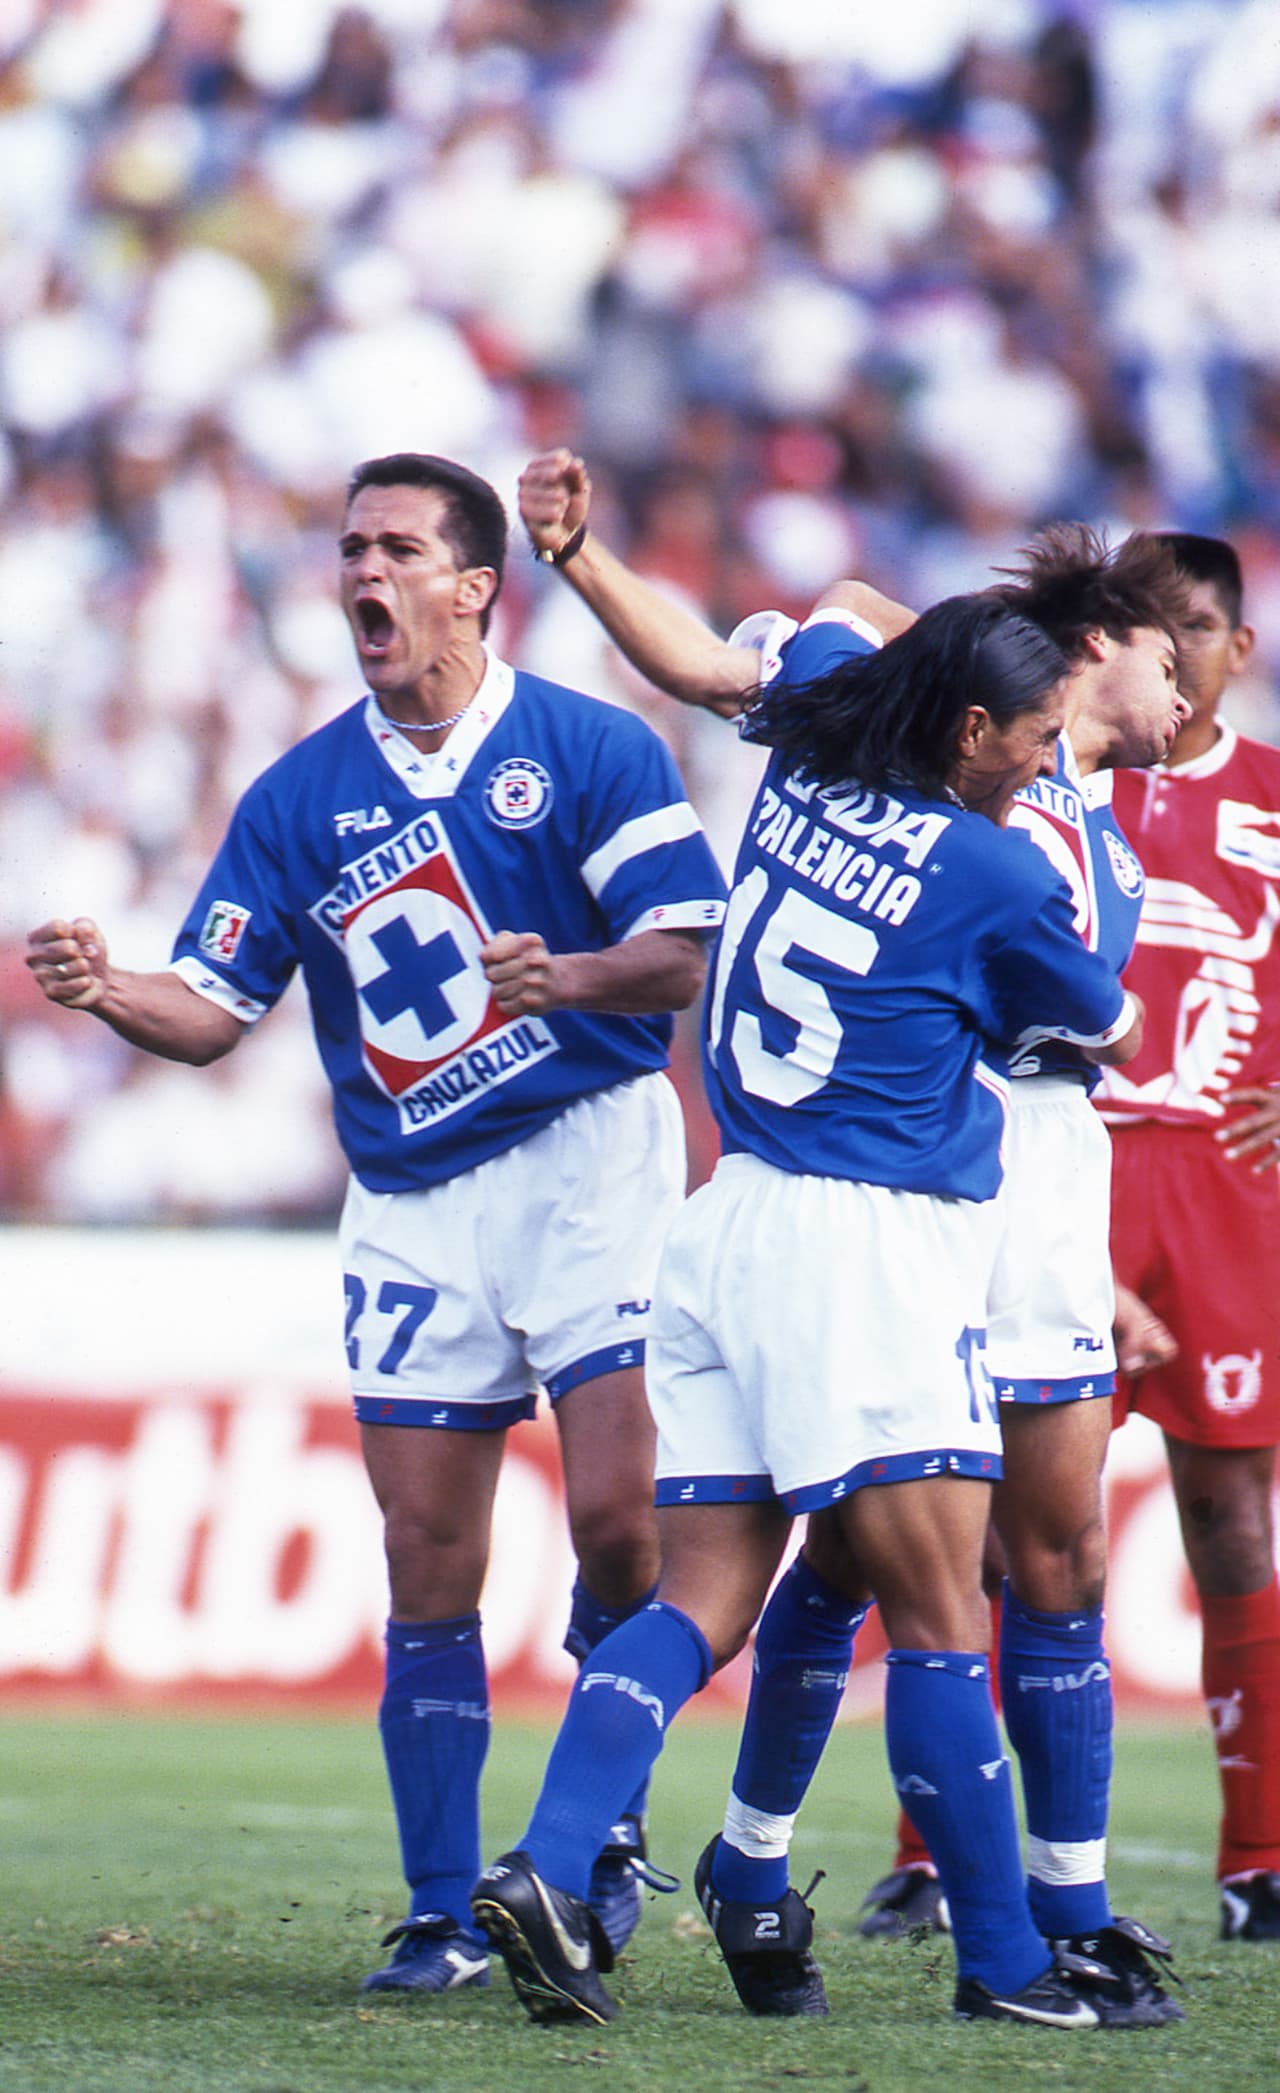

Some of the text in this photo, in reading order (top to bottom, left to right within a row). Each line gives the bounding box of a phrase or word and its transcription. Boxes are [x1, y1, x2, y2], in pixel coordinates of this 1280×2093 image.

[333, 805, 393, 837] FILA
[752, 786, 922, 927] PALENCIA
[708, 864, 881, 1108] 15
